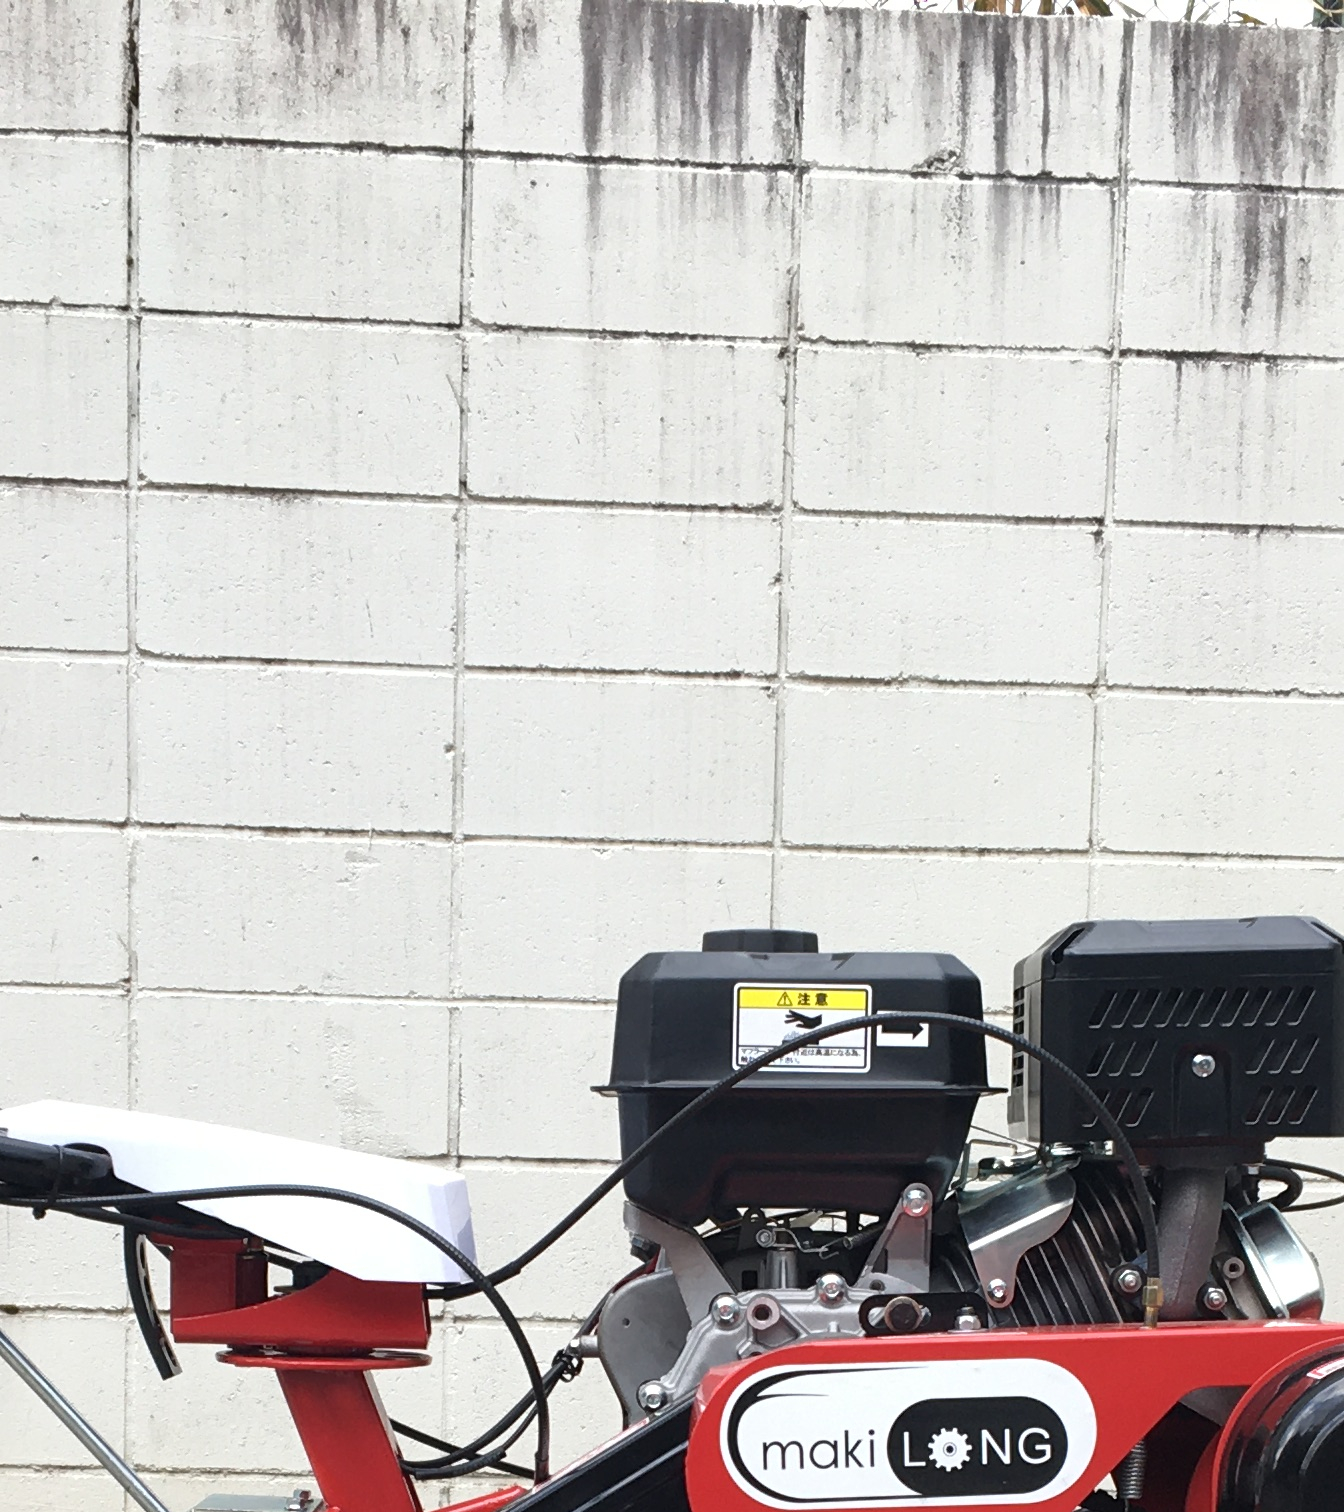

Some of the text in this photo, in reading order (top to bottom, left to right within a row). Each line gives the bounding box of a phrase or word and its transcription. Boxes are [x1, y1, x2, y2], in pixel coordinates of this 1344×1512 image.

[797, 992, 829, 1006] 注意
[762, 1426, 1053, 1473] maki LONG
